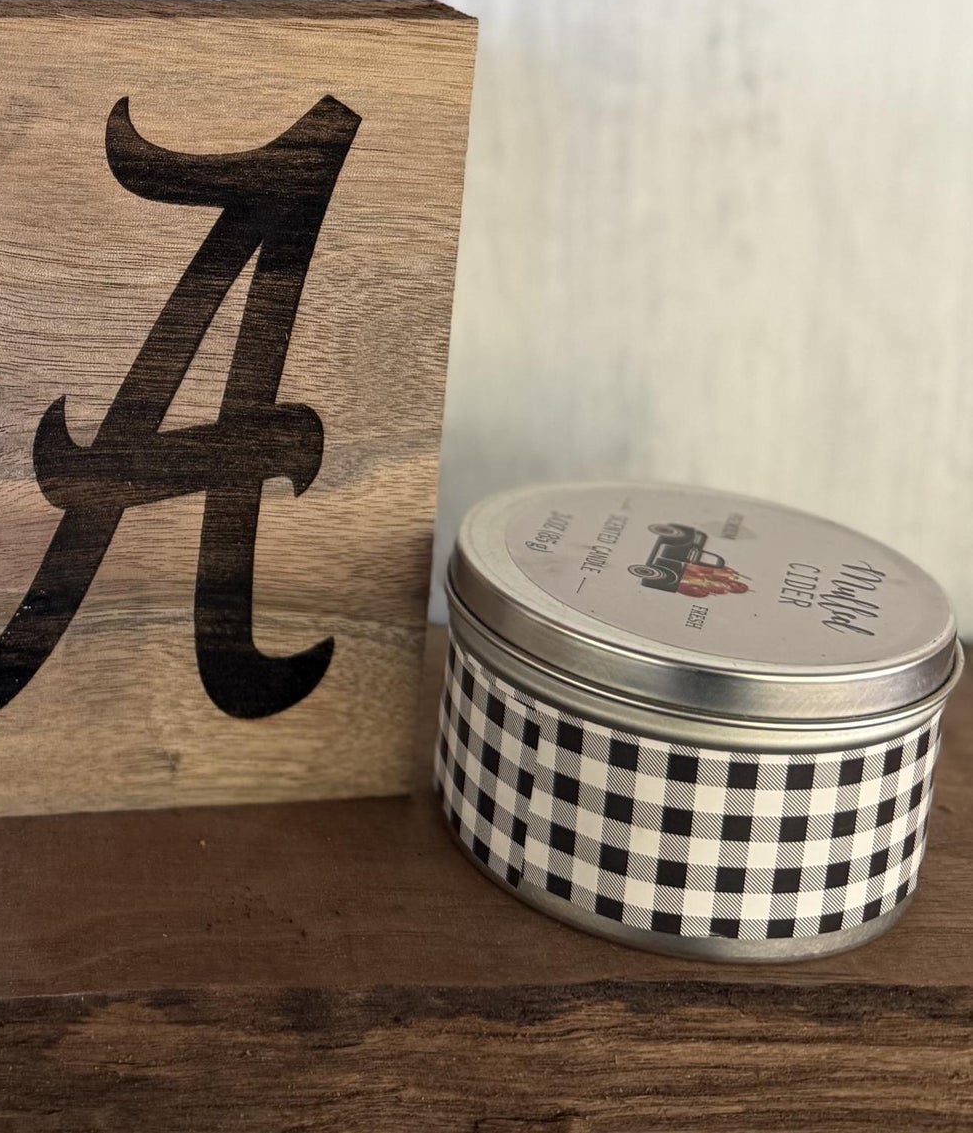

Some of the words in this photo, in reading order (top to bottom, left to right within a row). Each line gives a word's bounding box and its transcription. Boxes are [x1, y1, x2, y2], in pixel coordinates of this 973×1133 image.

[580, 545, 612, 574] CANDLE
[778, 562, 821, 609] CIDER
[817, 560, 886, 637] Mulled
[685, 604, 709, 630] FRESH
